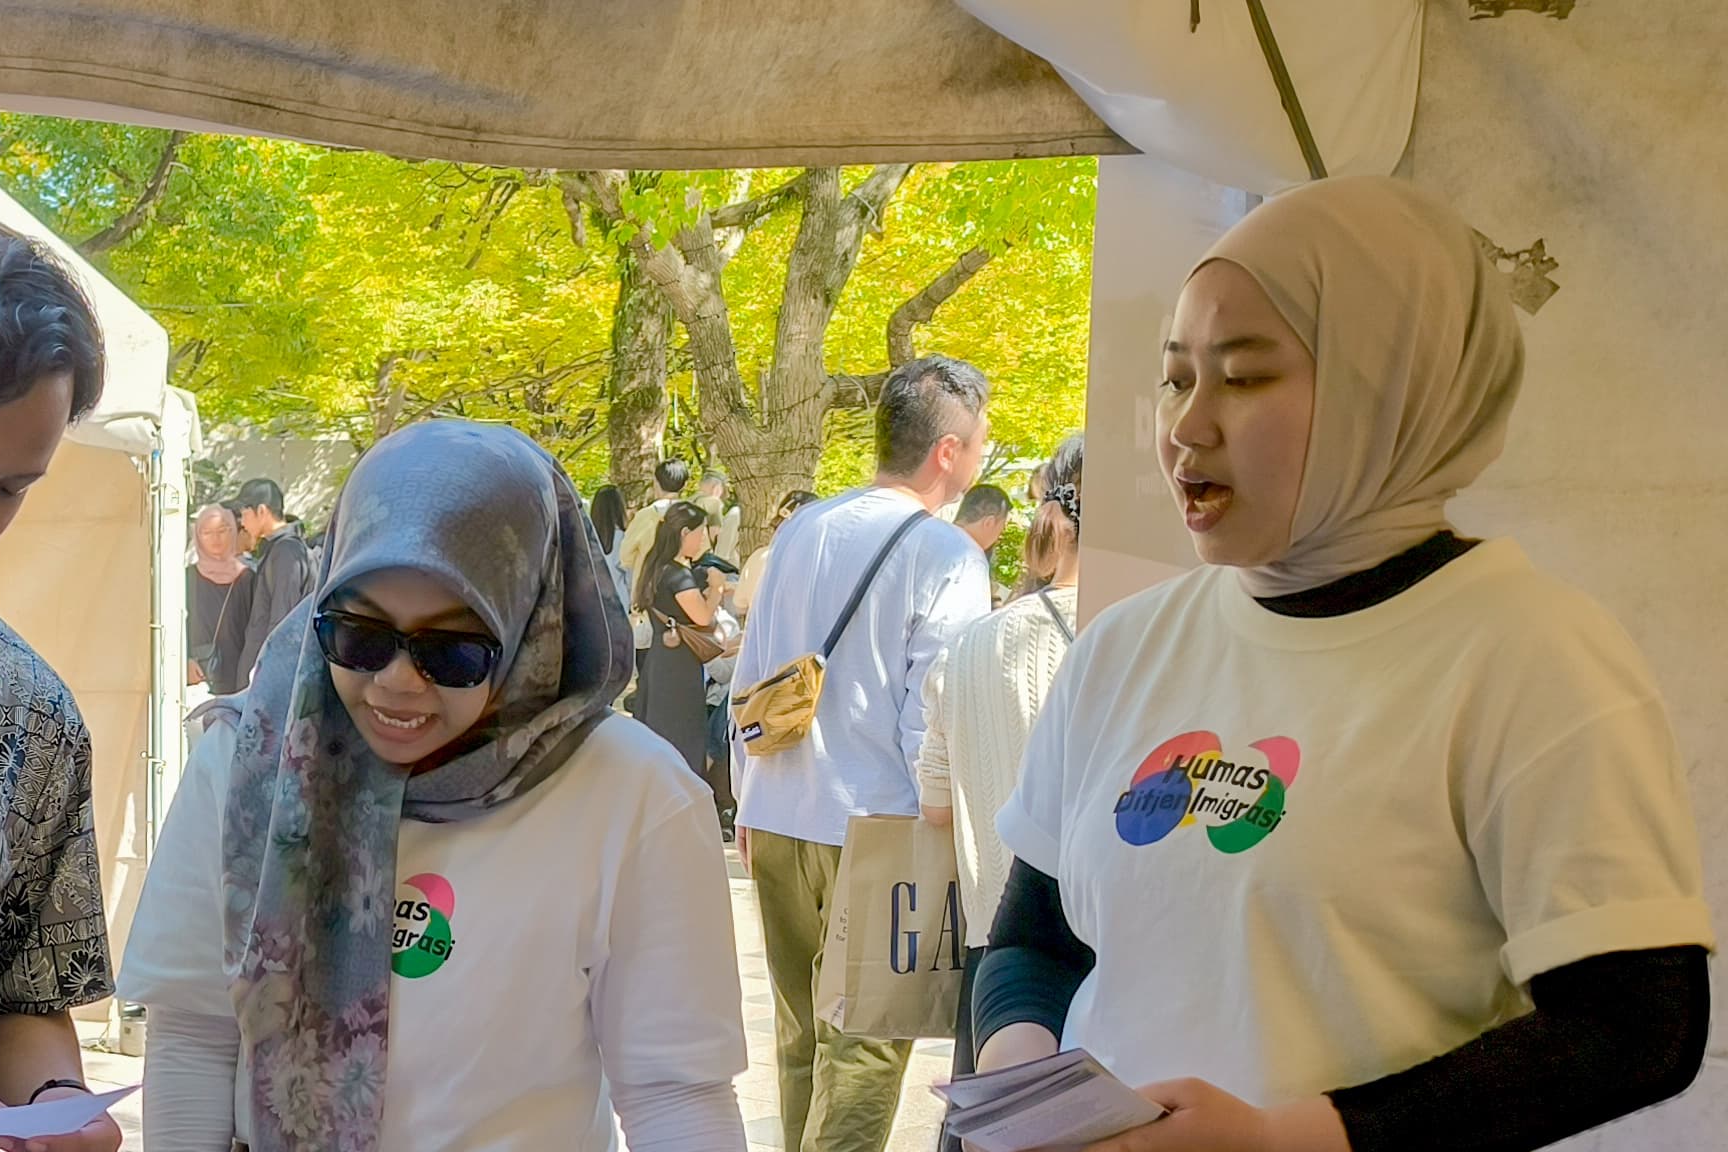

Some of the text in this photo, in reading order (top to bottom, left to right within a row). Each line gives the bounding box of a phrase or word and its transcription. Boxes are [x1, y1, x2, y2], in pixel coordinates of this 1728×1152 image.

[1162, 754, 1271, 791] Humas
[1189, 787, 1287, 833] Imigrasi
[393, 899, 431, 921] as
